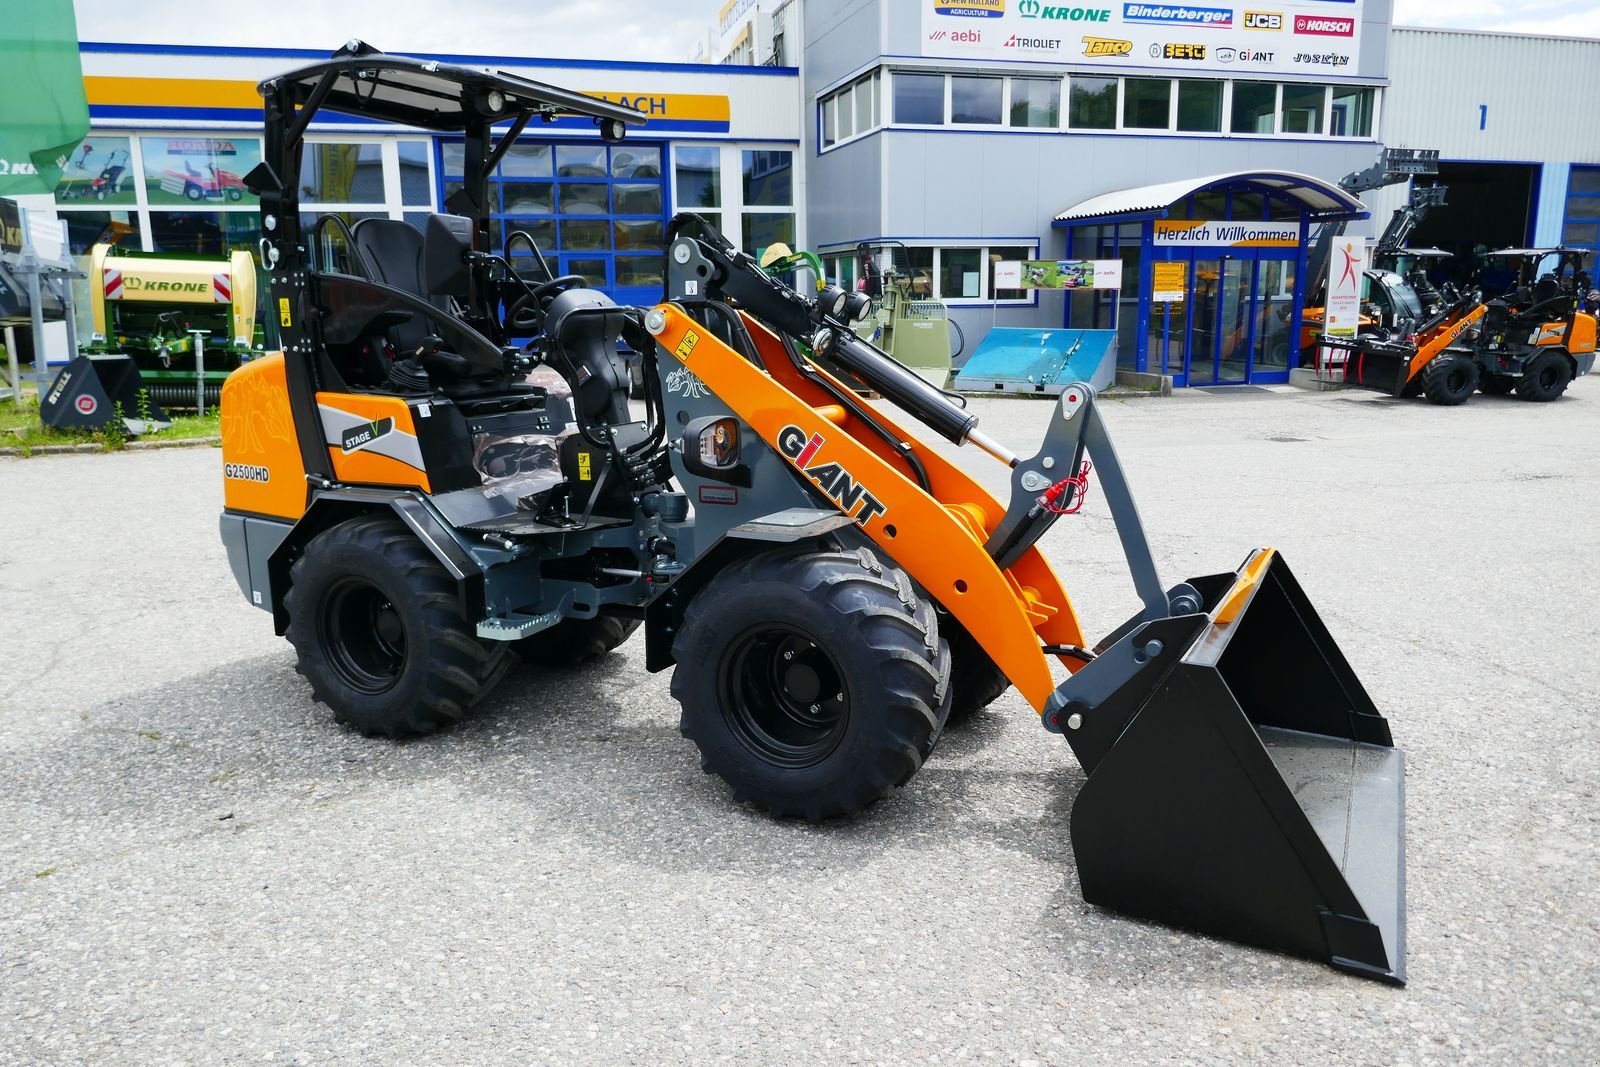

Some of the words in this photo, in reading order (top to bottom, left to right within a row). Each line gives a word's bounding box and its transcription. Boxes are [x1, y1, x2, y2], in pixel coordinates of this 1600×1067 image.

[950, 8, 989, 17] AGRICULTURE
[1041, 6, 1111, 22] KRONE
[1126, 5, 1231, 23] Binderberger
[1245, 14, 1282, 29] JCB
[1306, 20, 1351, 33] HORSCH
[951, 29, 982, 43] aebi
[1016, 38, 1062, 49] TRIOLIET
[1082, 37, 1133, 55] Tanco
[1293, 52, 1350, 66] JOSKIN
[1479, 104, 1488, 130] 1
[167, 141, 236, 150] HONDA
[1157, 226, 1210, 241] Herzlich
[1216, 226, 1297, 242] Willkommen
[144, 281, 208, 292] KRONE
[345, 430, 371, 448] STAGE
[225, 463, 270, 482] G2500HD
